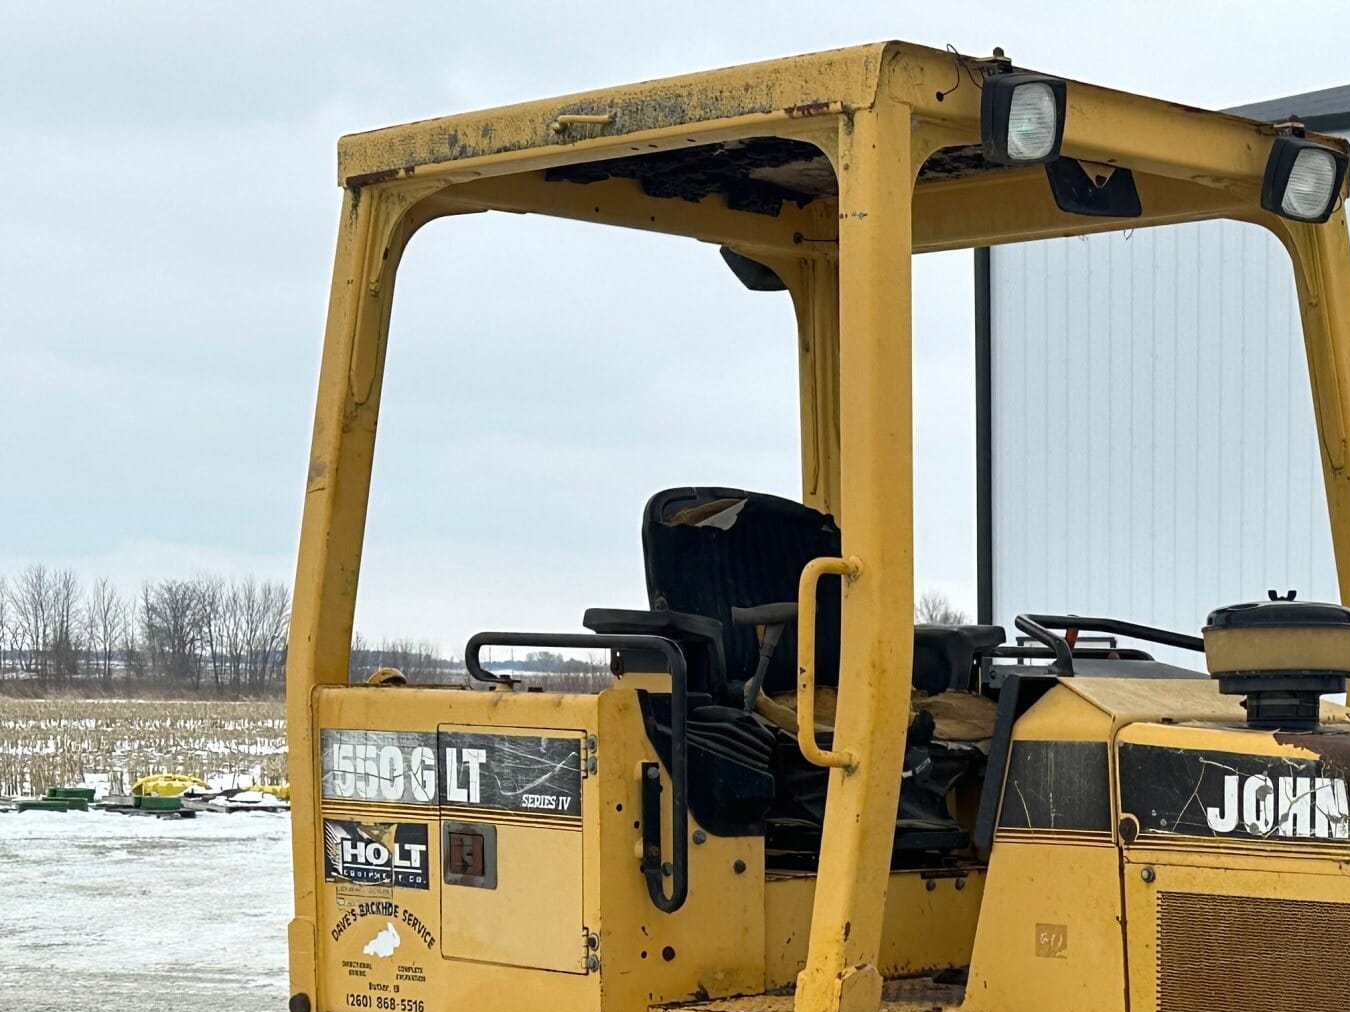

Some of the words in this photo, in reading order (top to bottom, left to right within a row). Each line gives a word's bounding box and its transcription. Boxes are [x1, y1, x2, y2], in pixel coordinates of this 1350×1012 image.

[522, 794, 557, 809] SERIES
[558, 796, 571, 810] IV
[1206, 775, 1349, 838] JOHN
[342, 840, 427, 867] HOLT
[331, 908, 358, 942] DAVE'S
[358, 901, 399, 918] BACKHOE
[401, 909, 436, 950] SERVICE
[346, 993, 372, 1008] (260)
